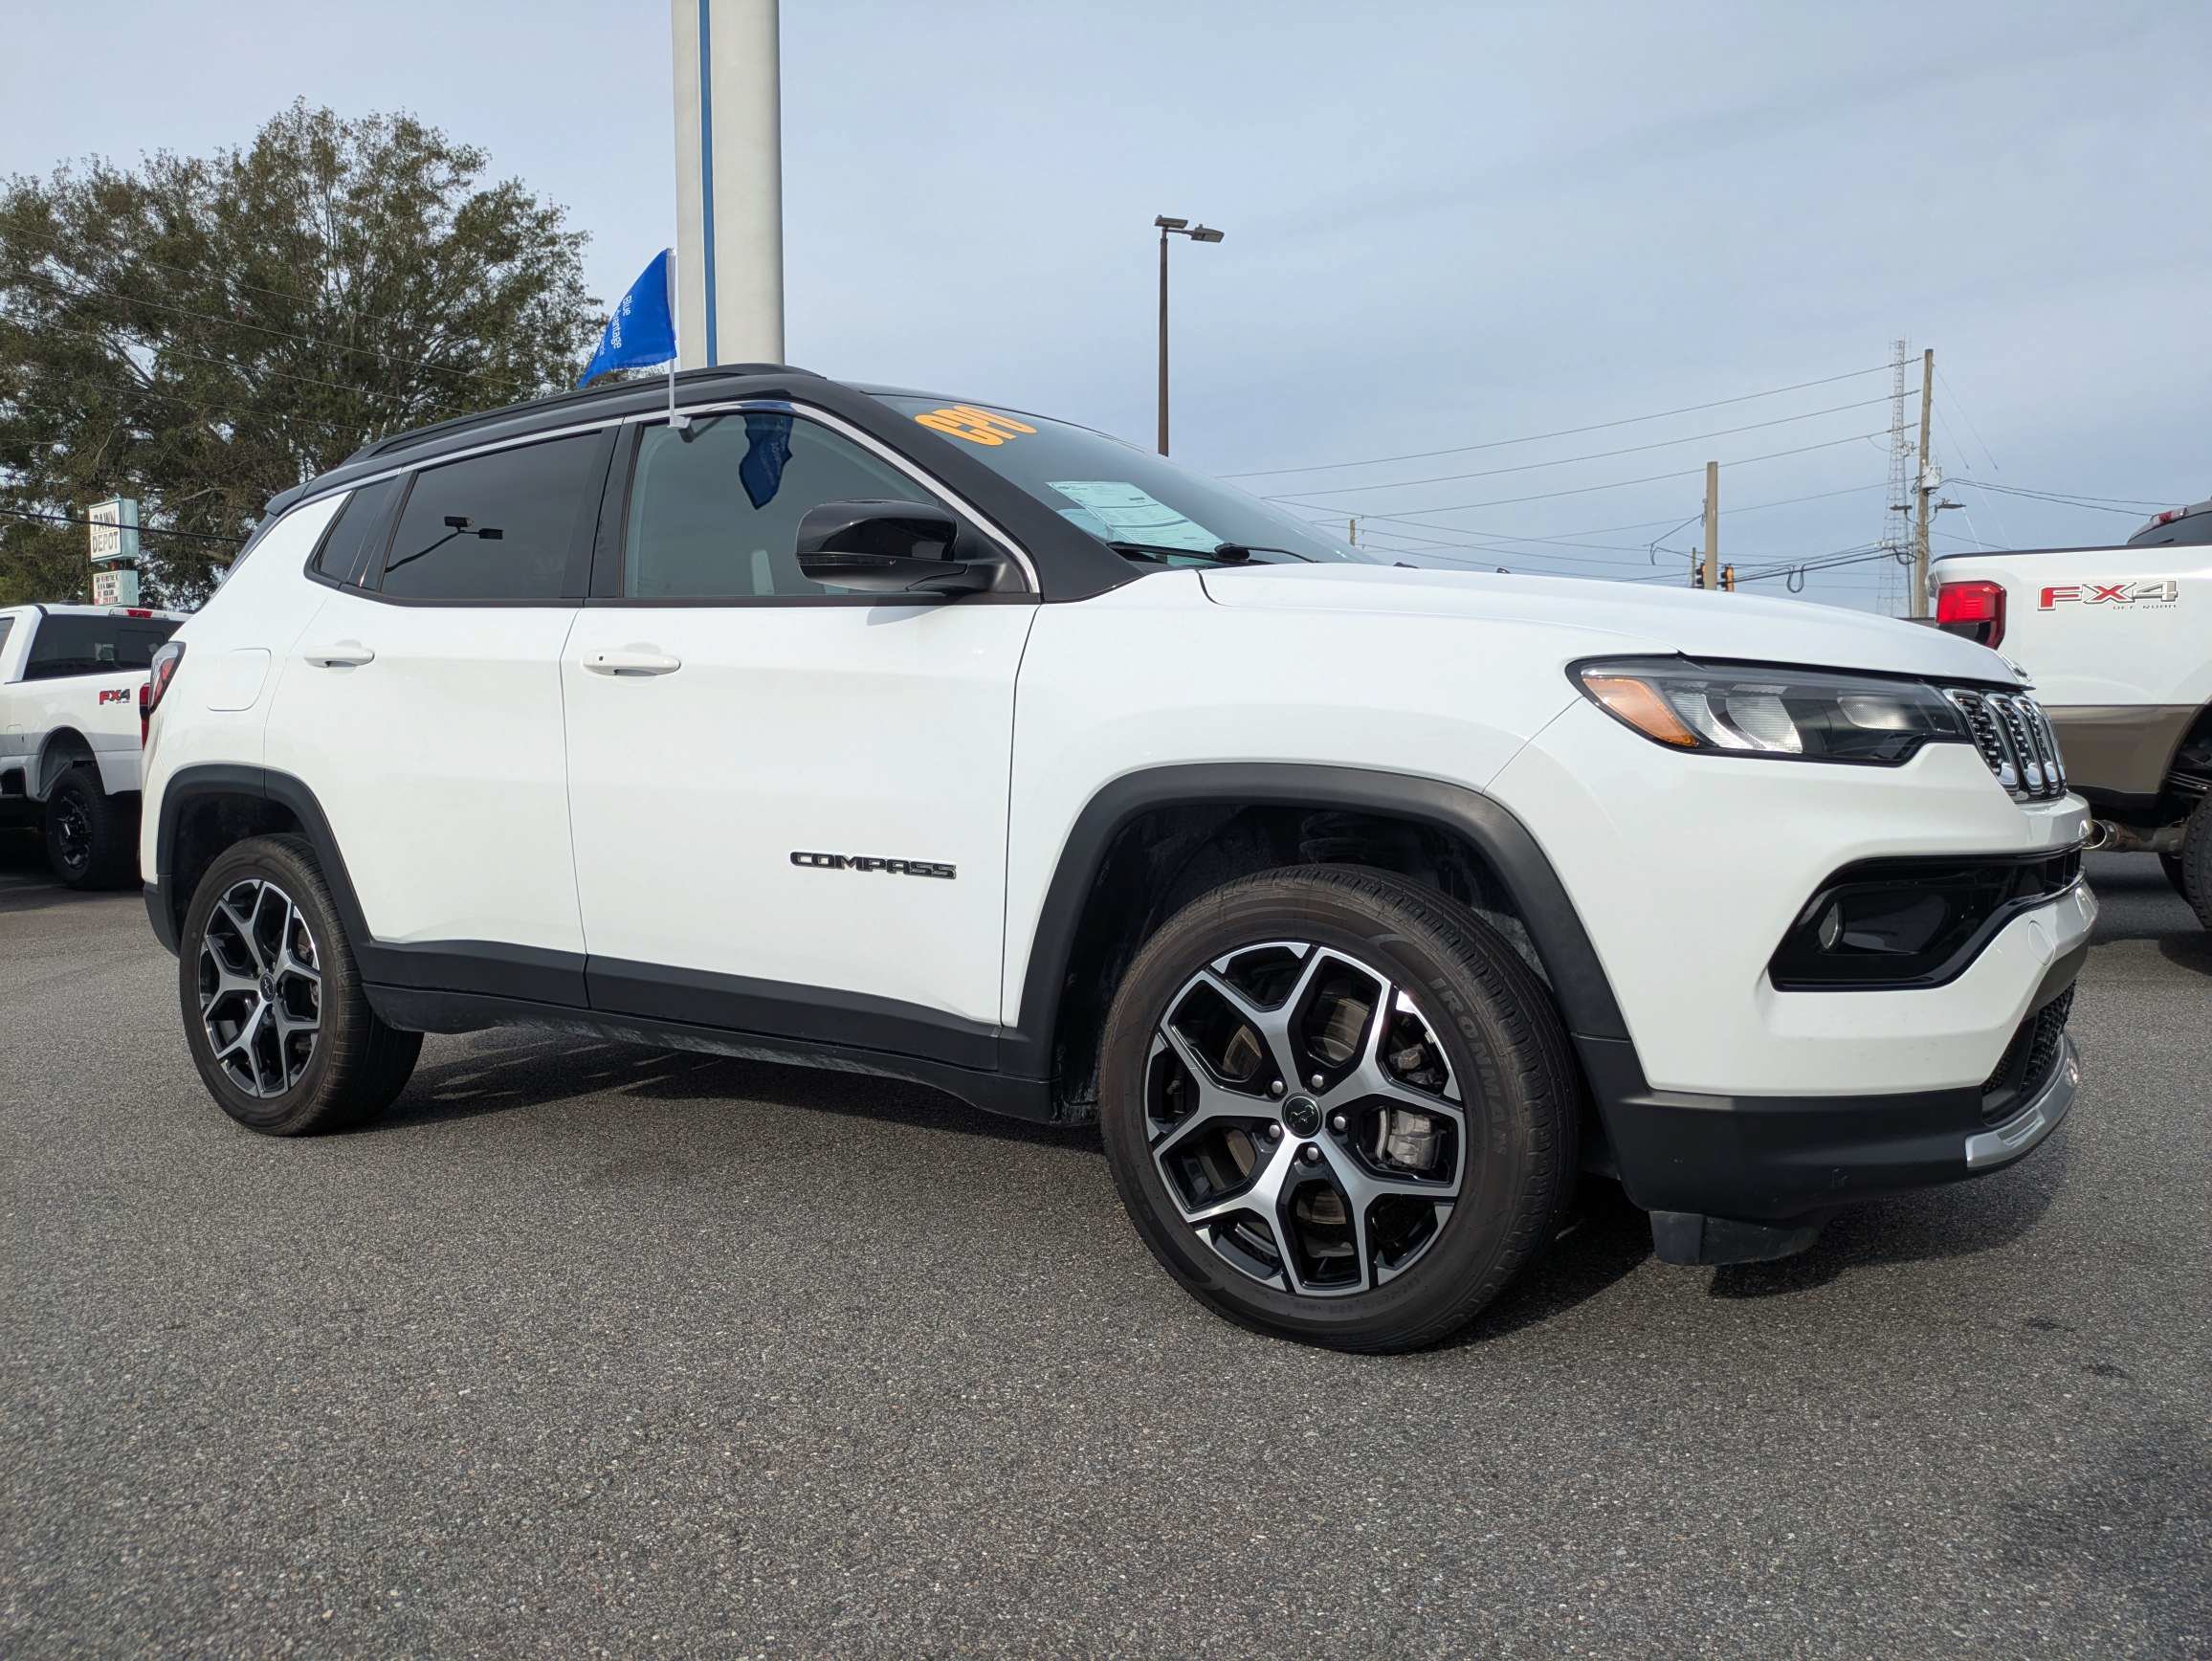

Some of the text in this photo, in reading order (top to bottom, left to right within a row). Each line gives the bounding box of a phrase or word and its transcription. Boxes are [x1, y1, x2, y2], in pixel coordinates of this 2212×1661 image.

[610, 308, 622, 350] vantage
[914, 405, 1038, 447] CPO
[93, 509, 116, 532] PAWN
[92, 531, 119, 553] DEPOT
[2037, 580, 2179, 611] FX4
[100, 688, 131, 705] FX4
[789, 851, 958, 879] COMPASS
[1427, 977, 1509, 1155] IRONMAN
